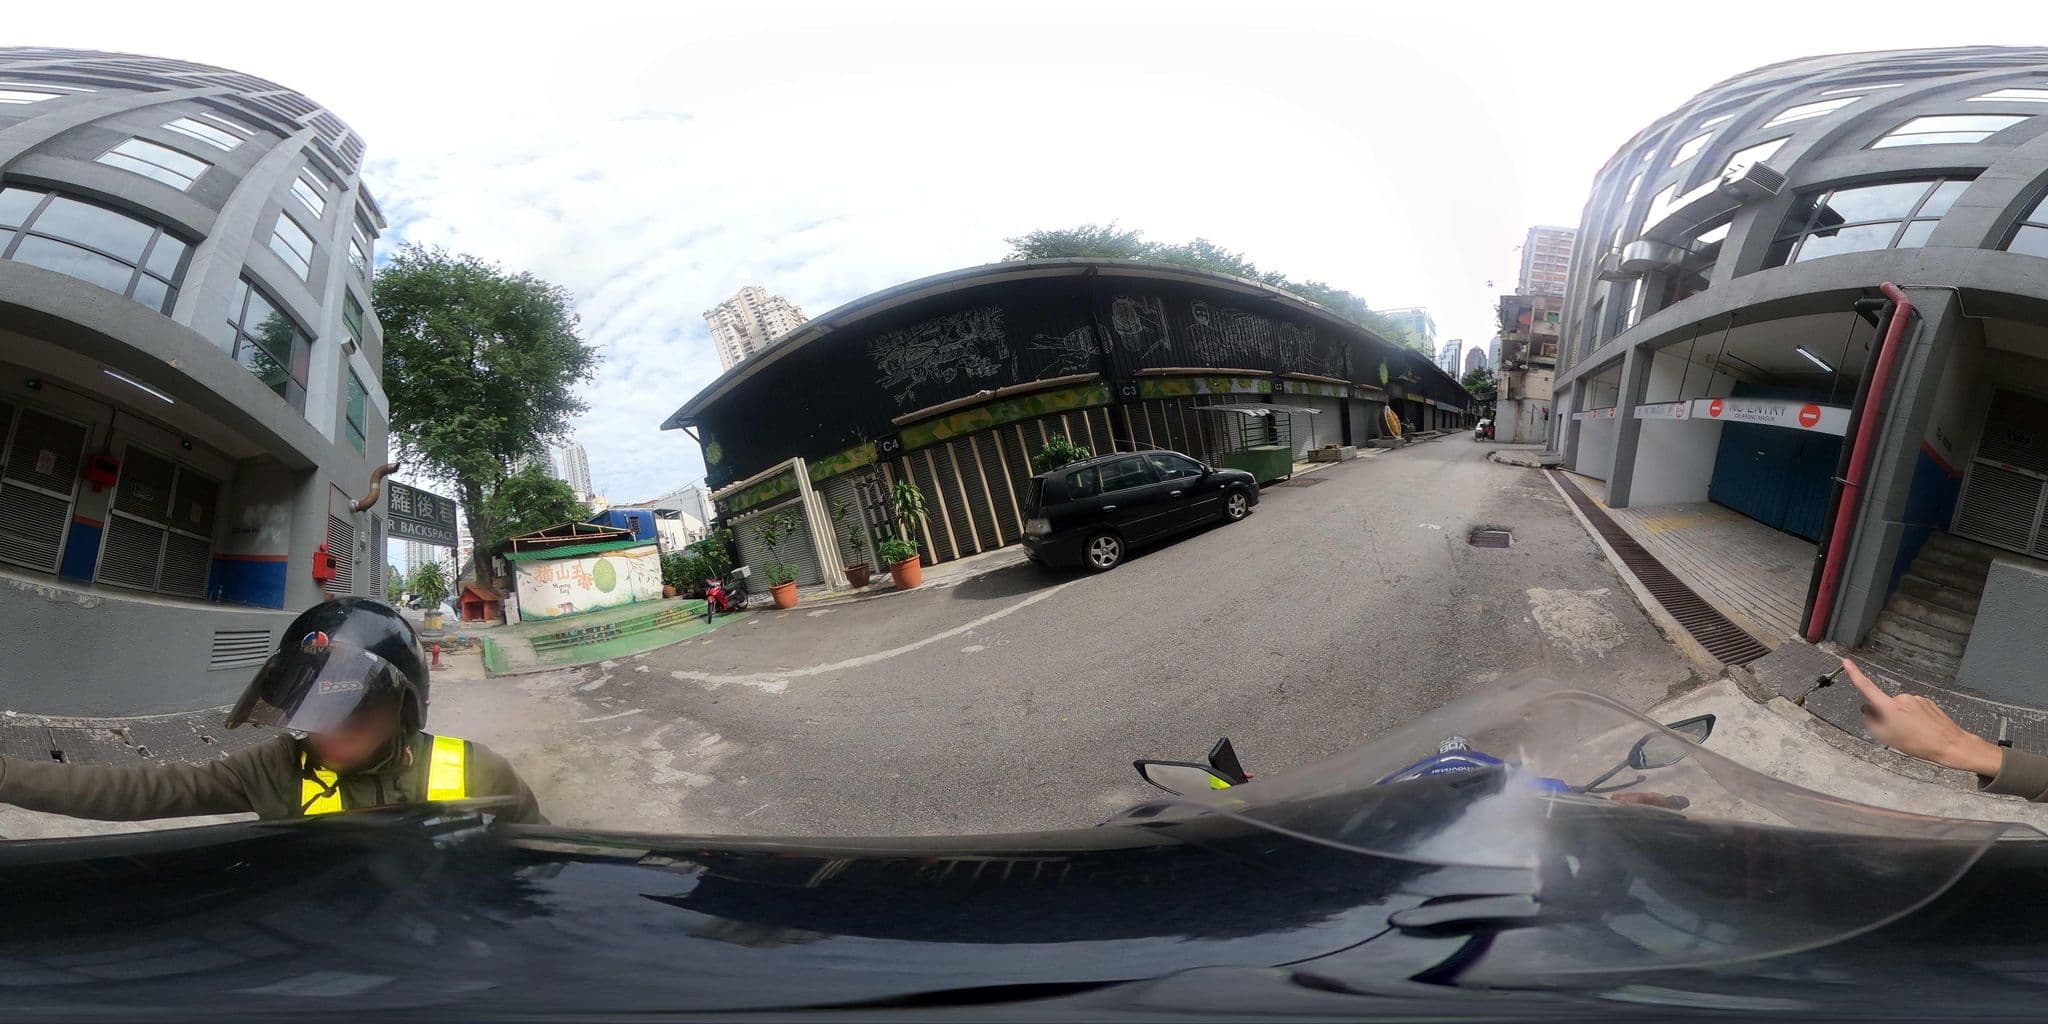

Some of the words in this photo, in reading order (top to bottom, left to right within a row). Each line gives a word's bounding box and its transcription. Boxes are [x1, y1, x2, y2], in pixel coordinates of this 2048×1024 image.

[1122, 386, 1137, 396] C3
[883, 439, 899, 451] C4
[388, 519, 395, 531] R
